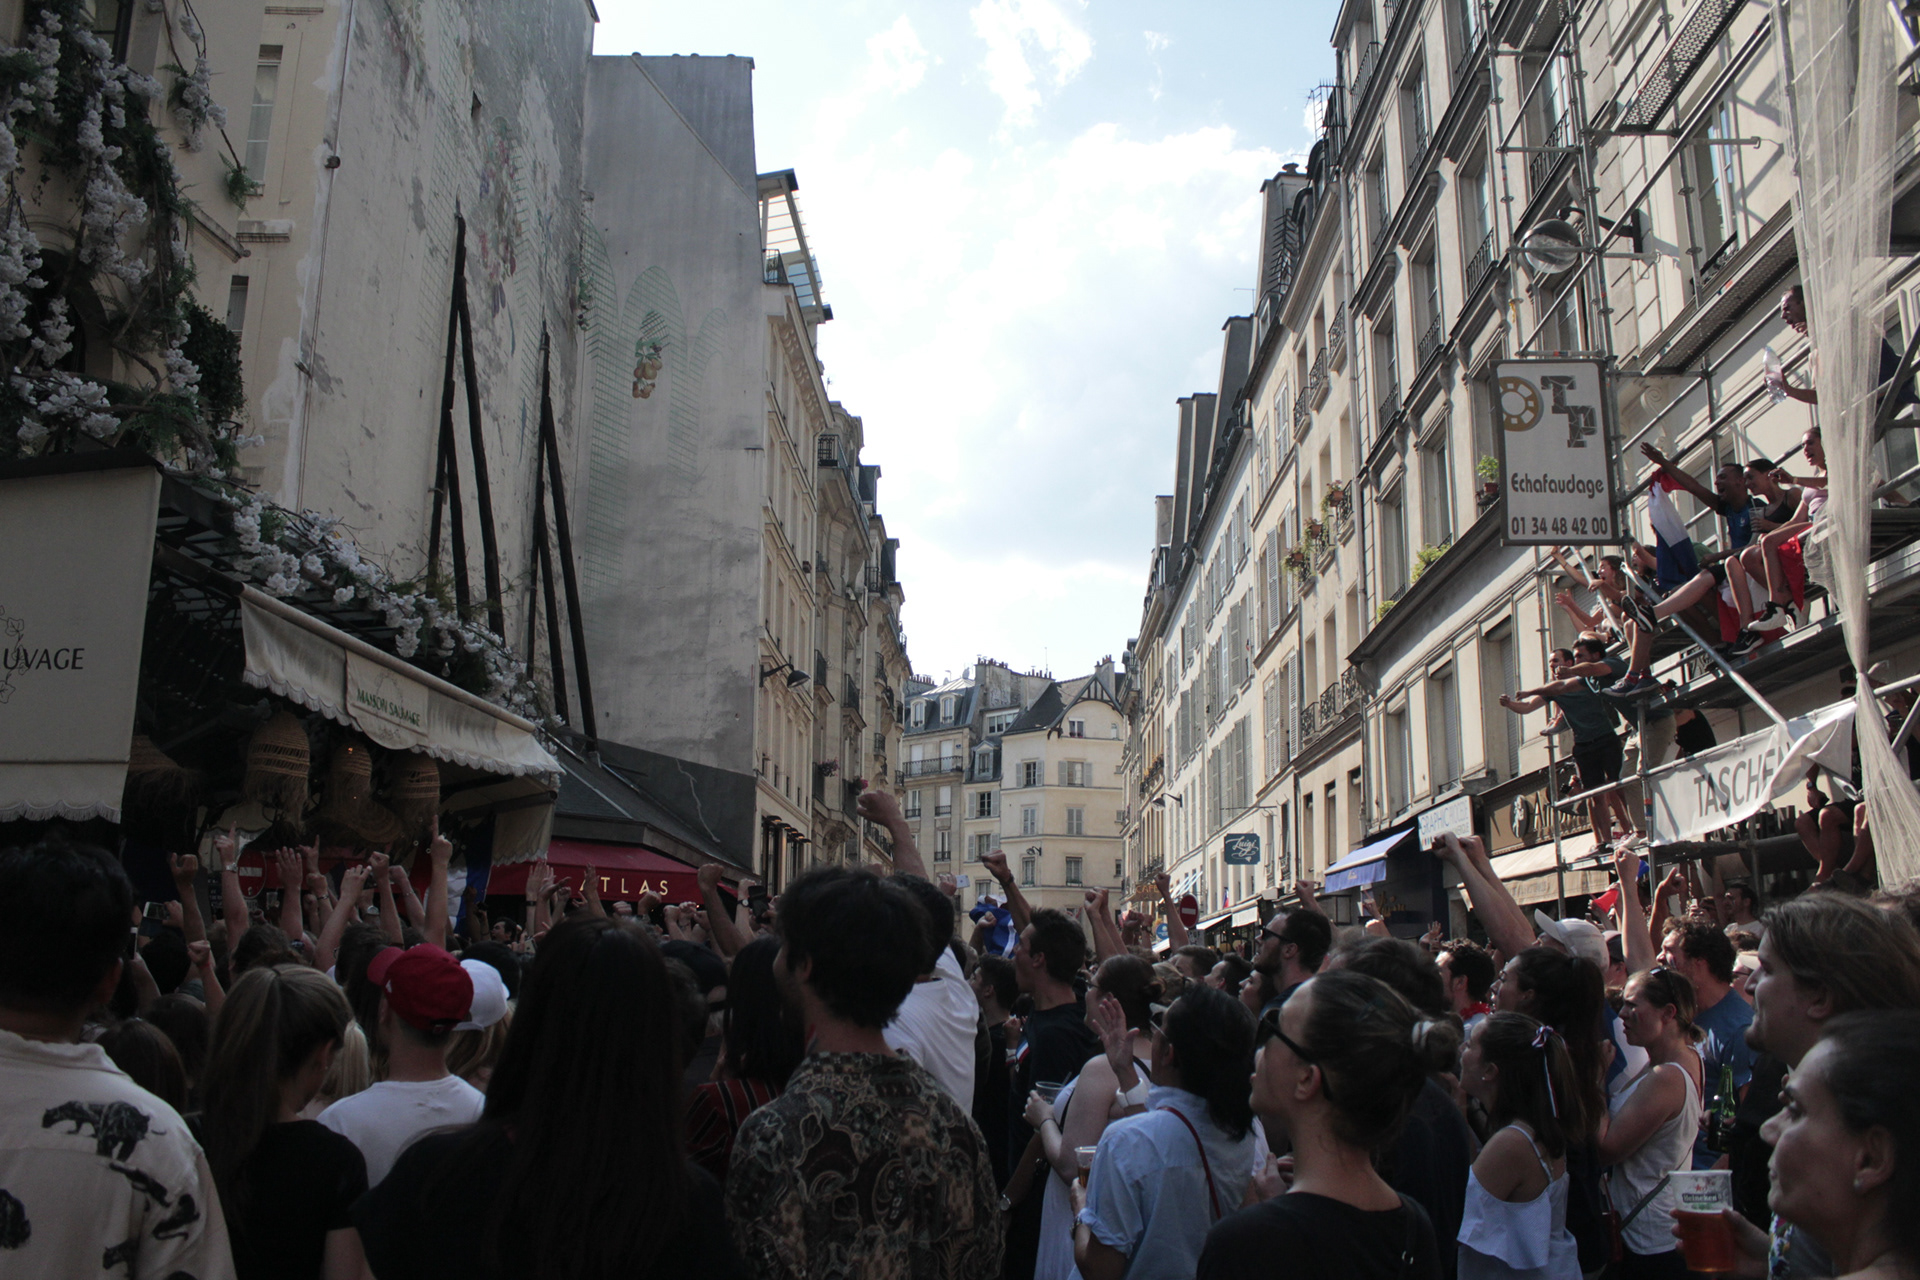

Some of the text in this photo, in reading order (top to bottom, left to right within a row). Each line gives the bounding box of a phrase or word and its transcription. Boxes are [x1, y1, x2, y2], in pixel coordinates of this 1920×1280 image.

[1510, 472, 1604, 499] Echafaudage
[1511, 516, 1608, 536] 01 34 48 42 00
[356, 688, 421, 727] MAISON SAUVAGE
